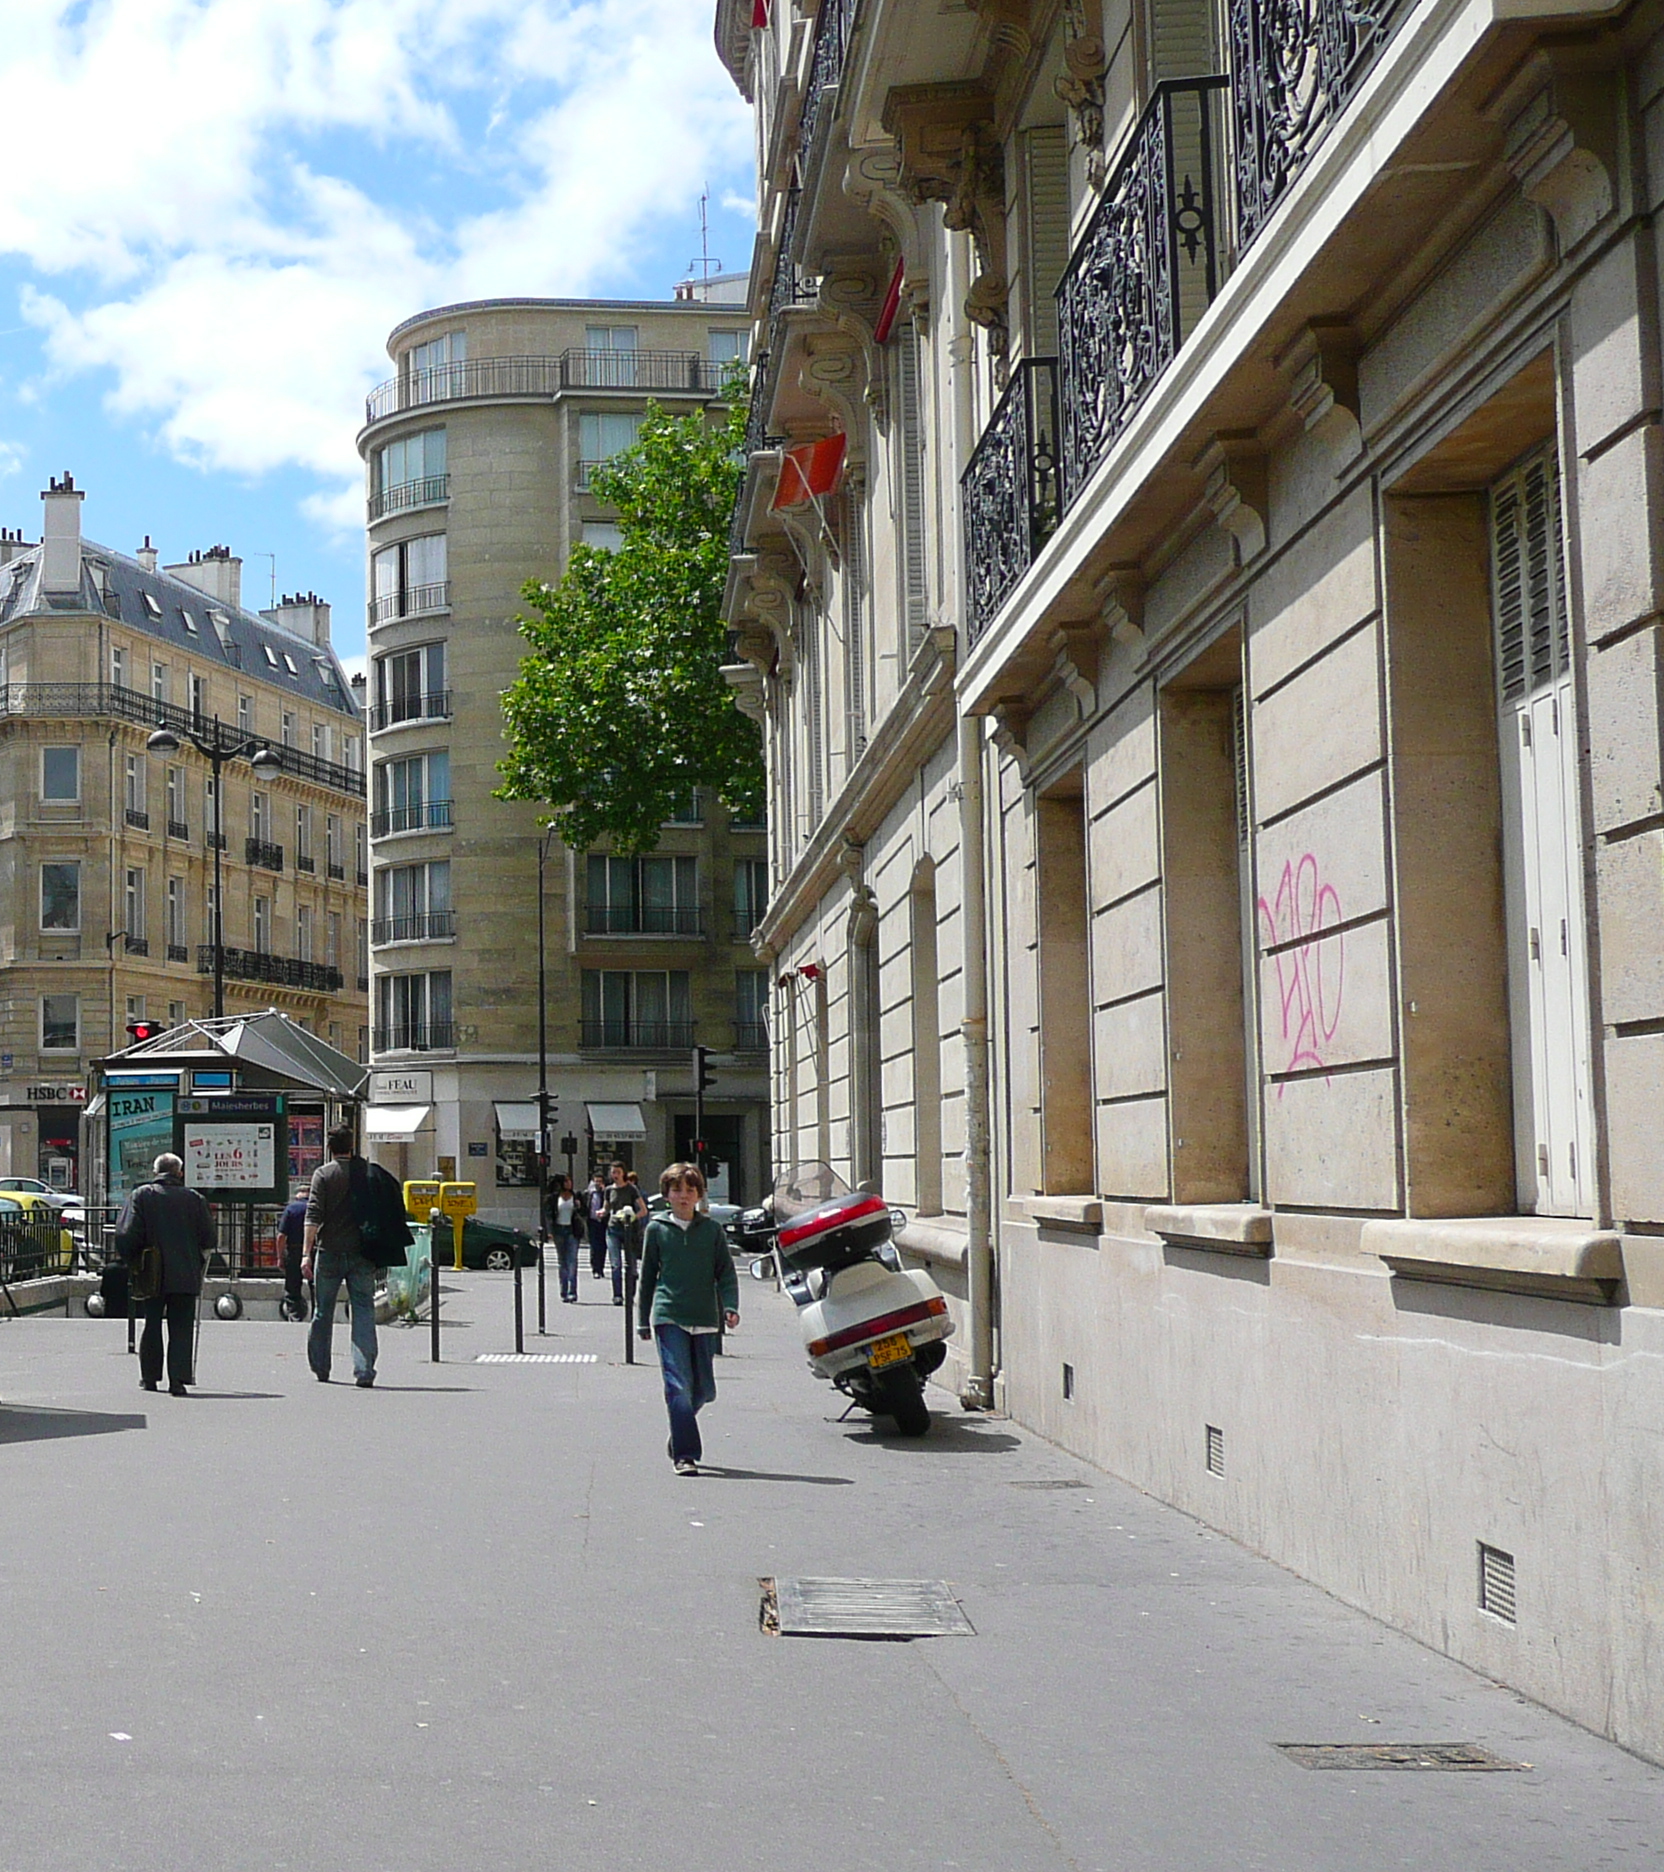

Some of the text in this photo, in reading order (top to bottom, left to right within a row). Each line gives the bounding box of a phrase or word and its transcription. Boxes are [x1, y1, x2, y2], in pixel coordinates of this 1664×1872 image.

[388, 1079, 417, 1090] FEAU
[27, 1087, 67, 1100] HSBC
[112, 1096, 155, 1117] IRAN
[233, 1147, 243, 1159] 6
[214, 1160, 243, 1168] JOURS
[873, 1345, 908, 1364] PSF 75
